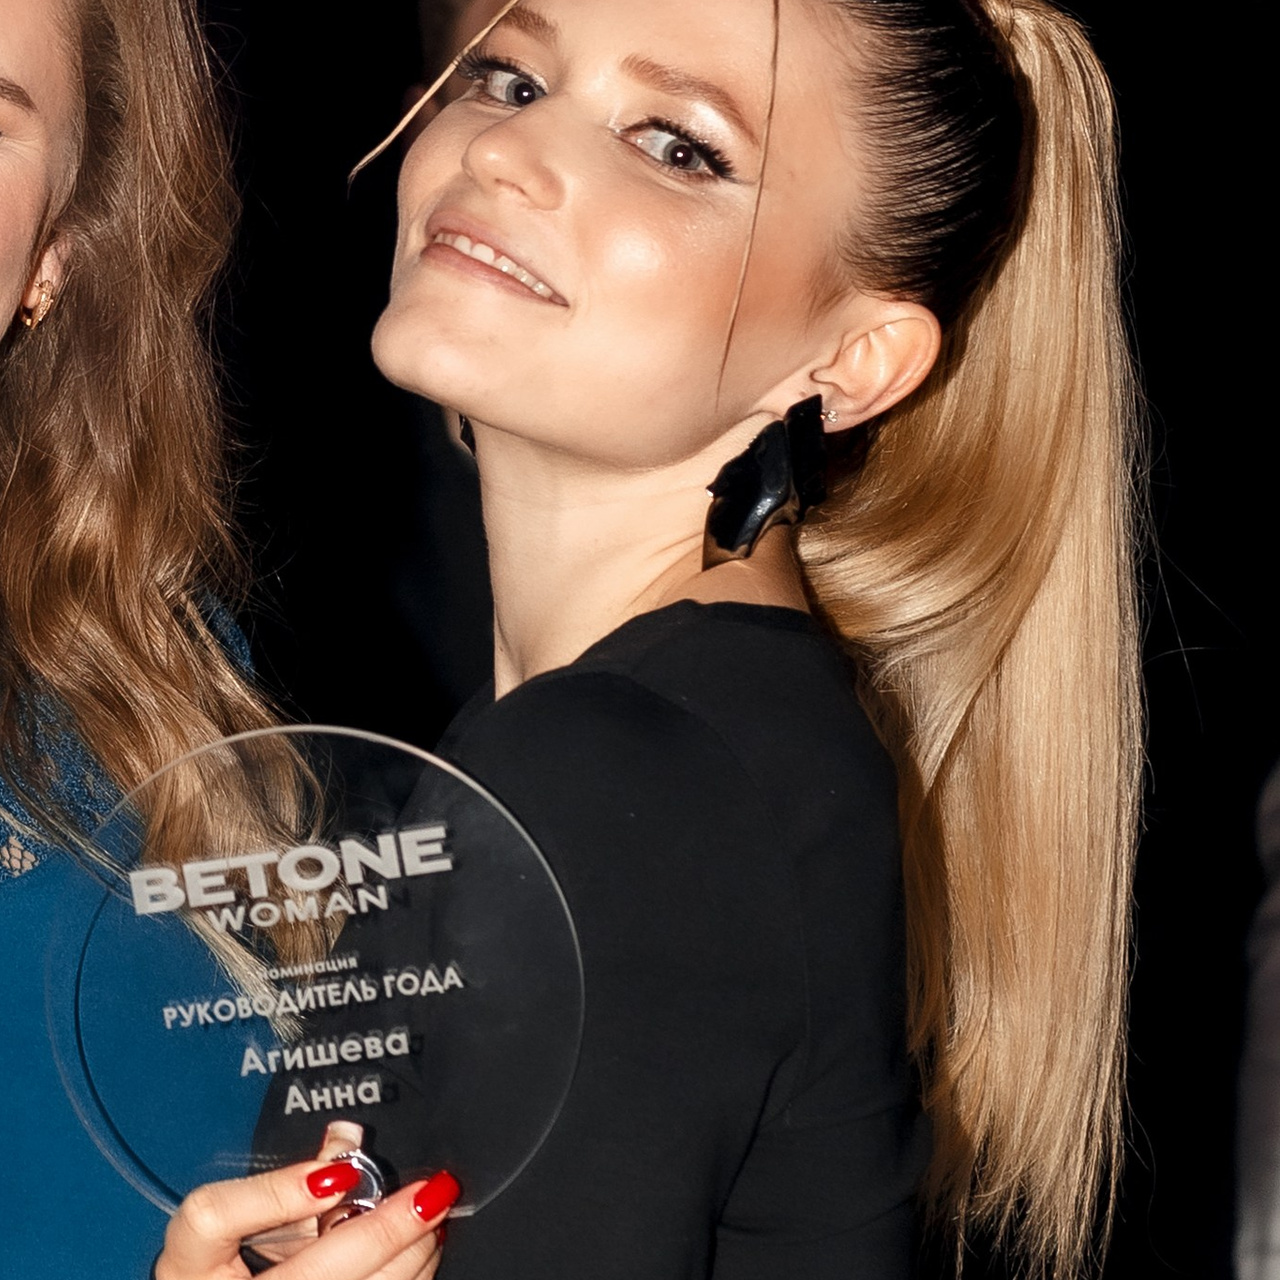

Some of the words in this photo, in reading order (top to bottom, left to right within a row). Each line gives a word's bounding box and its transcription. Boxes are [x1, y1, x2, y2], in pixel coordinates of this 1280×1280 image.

[129, 825, 453, 916] BETONE
[208, 884, 389, 934] WOMAN
[261, 955, 359, 981] номинация
[162, 979, 377, 1030] РУКОВОДИТЕЛЬ
[382, 966, 464, 999] ГОДА
[240, 1032, 410, 1078] Агишева
[284, 1080, 382, 1116] Анна
